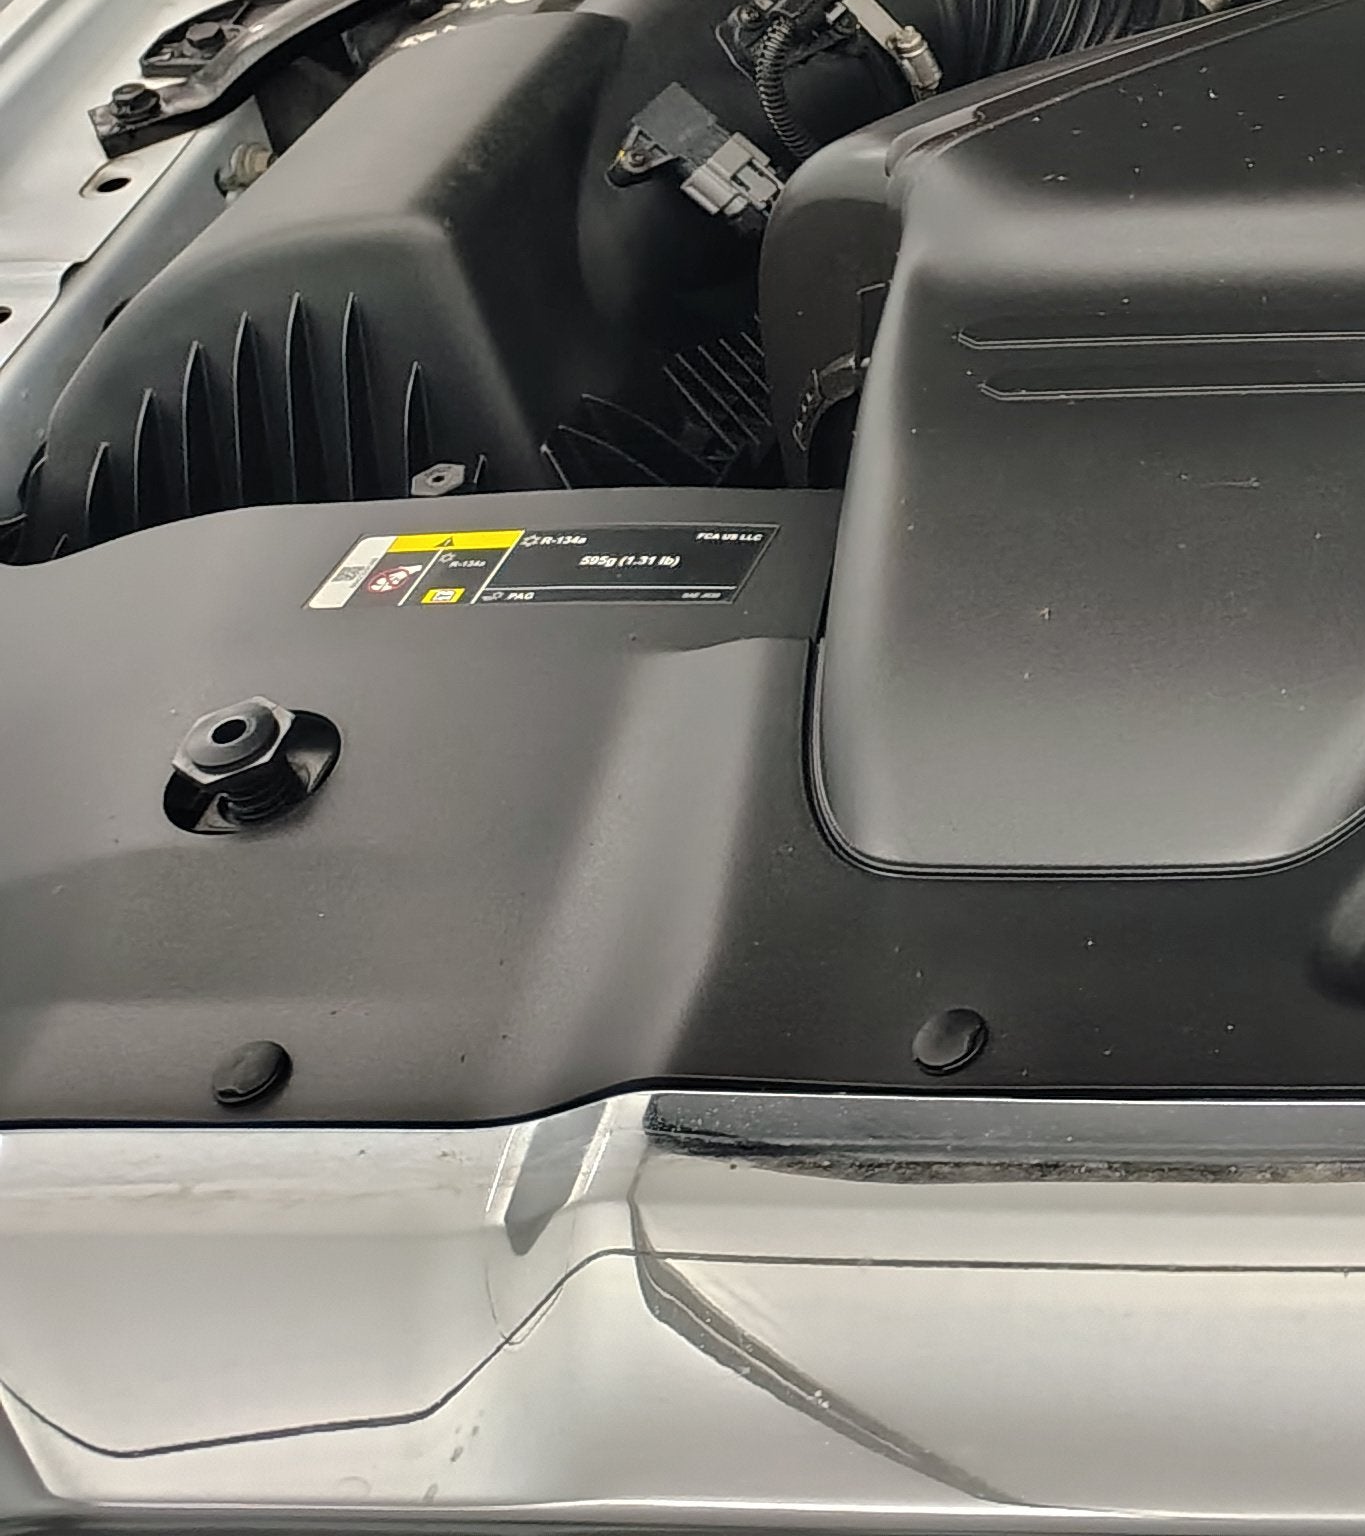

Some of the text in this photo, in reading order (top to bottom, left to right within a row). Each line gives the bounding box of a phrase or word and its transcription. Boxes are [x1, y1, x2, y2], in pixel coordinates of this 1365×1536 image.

[540, 535, 588, 545] R-134a
[739, 533, 764, 542] LLC
[579, 555, 681, 568] 595g (1.31 lb)
